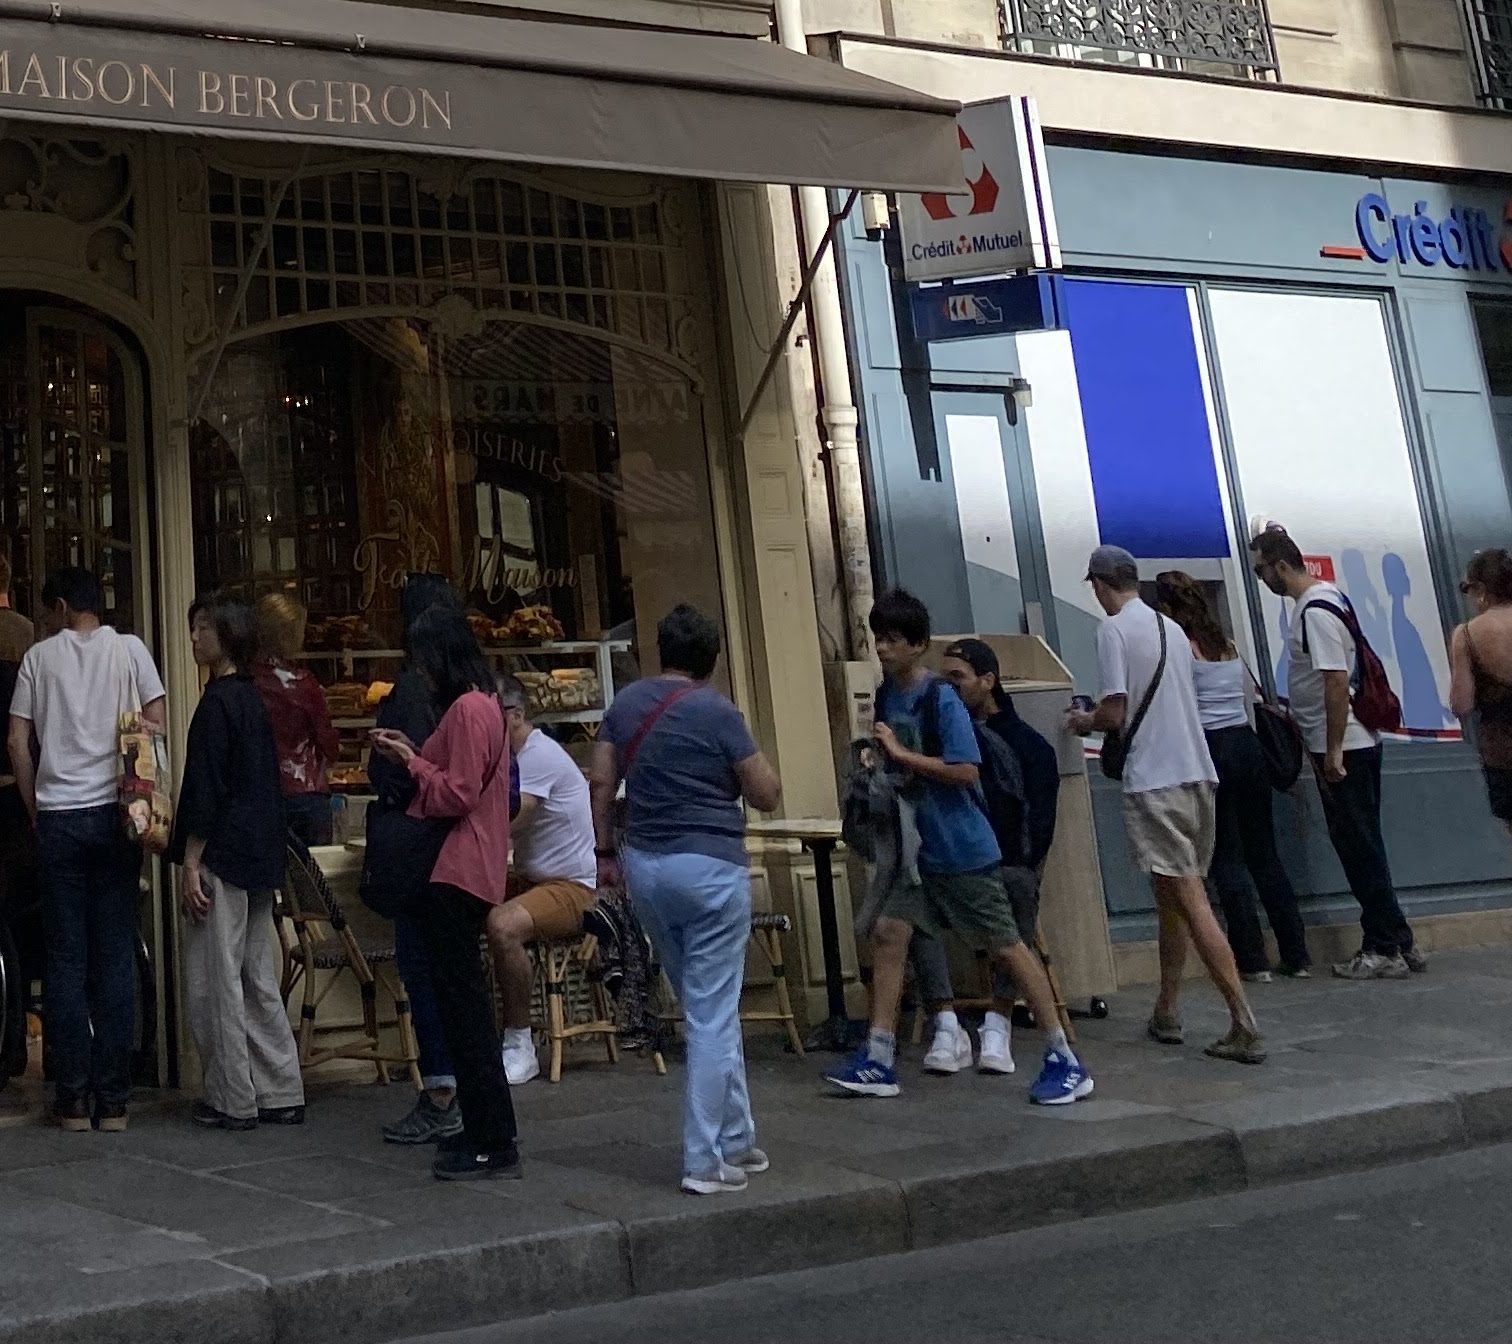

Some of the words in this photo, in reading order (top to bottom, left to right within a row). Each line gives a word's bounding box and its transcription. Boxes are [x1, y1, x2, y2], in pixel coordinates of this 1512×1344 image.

[198, 70, 452, 130] BERGERON
[912, 240, 956, 260] Crédit
[973, 230, 1023, 253] Mutuel
[1356, 193, 1499, 272] Crédit
[465, 533, 579, 605] Maison
